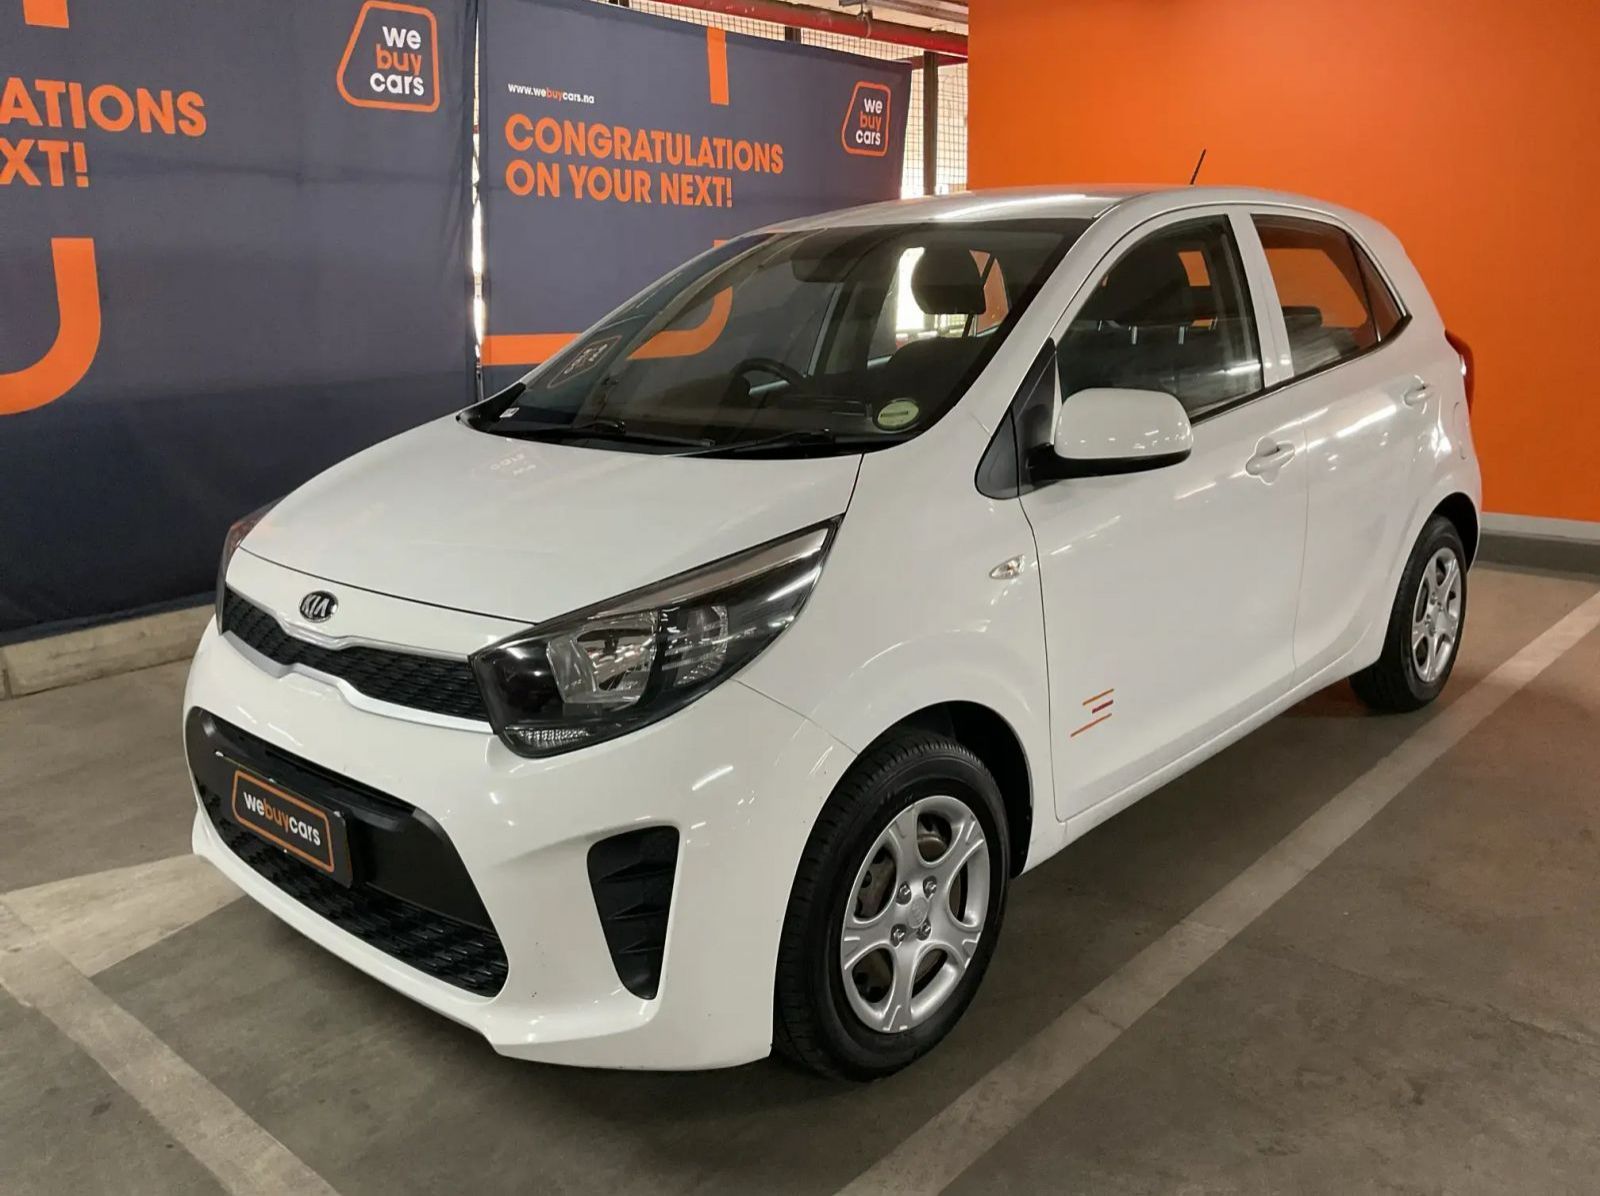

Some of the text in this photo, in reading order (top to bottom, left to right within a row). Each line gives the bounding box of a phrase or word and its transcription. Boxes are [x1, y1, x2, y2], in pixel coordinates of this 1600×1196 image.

[382, 25, 422, 50] we
[376, 43, 422, 76] buy
[369, 72, 425, 97] cars
[0, 76, 207, 137] ATIONS
[863, 97, 883, 114] we
[860, 110, 882, 132] buy
[504, 113, 784, 175] CONGRATULATIONS
[855, 129, 881, 146] cars
[505, 159, 734, 208] ON YOUR NEXT!
[301, 594, 330, 618] KIA
[243, 791, 321, 846] webuycars
